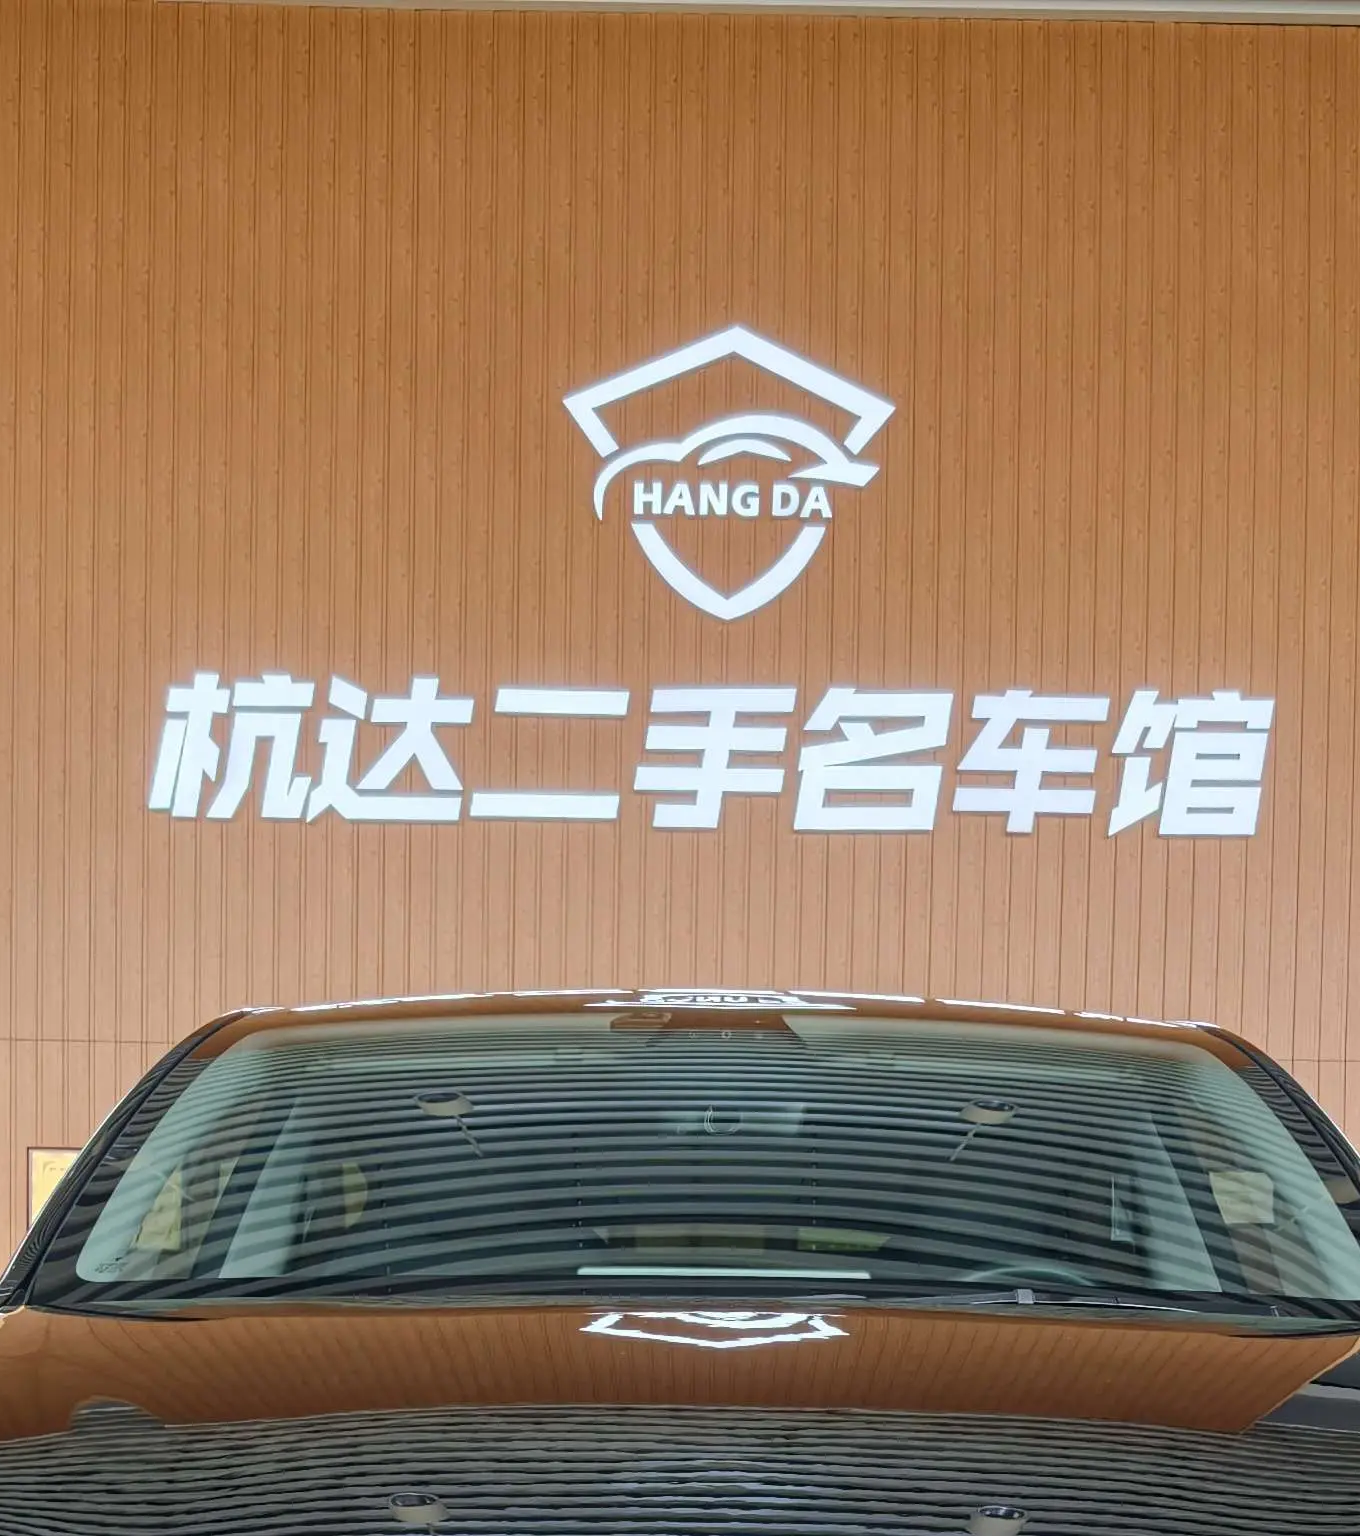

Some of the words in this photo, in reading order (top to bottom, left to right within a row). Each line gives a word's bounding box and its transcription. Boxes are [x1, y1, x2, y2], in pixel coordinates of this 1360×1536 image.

[633, 480, 760, 517] HANG
[771, 482, 833, 518] DA
[147, 671, 1276, 838] 杭达二手名车馆
